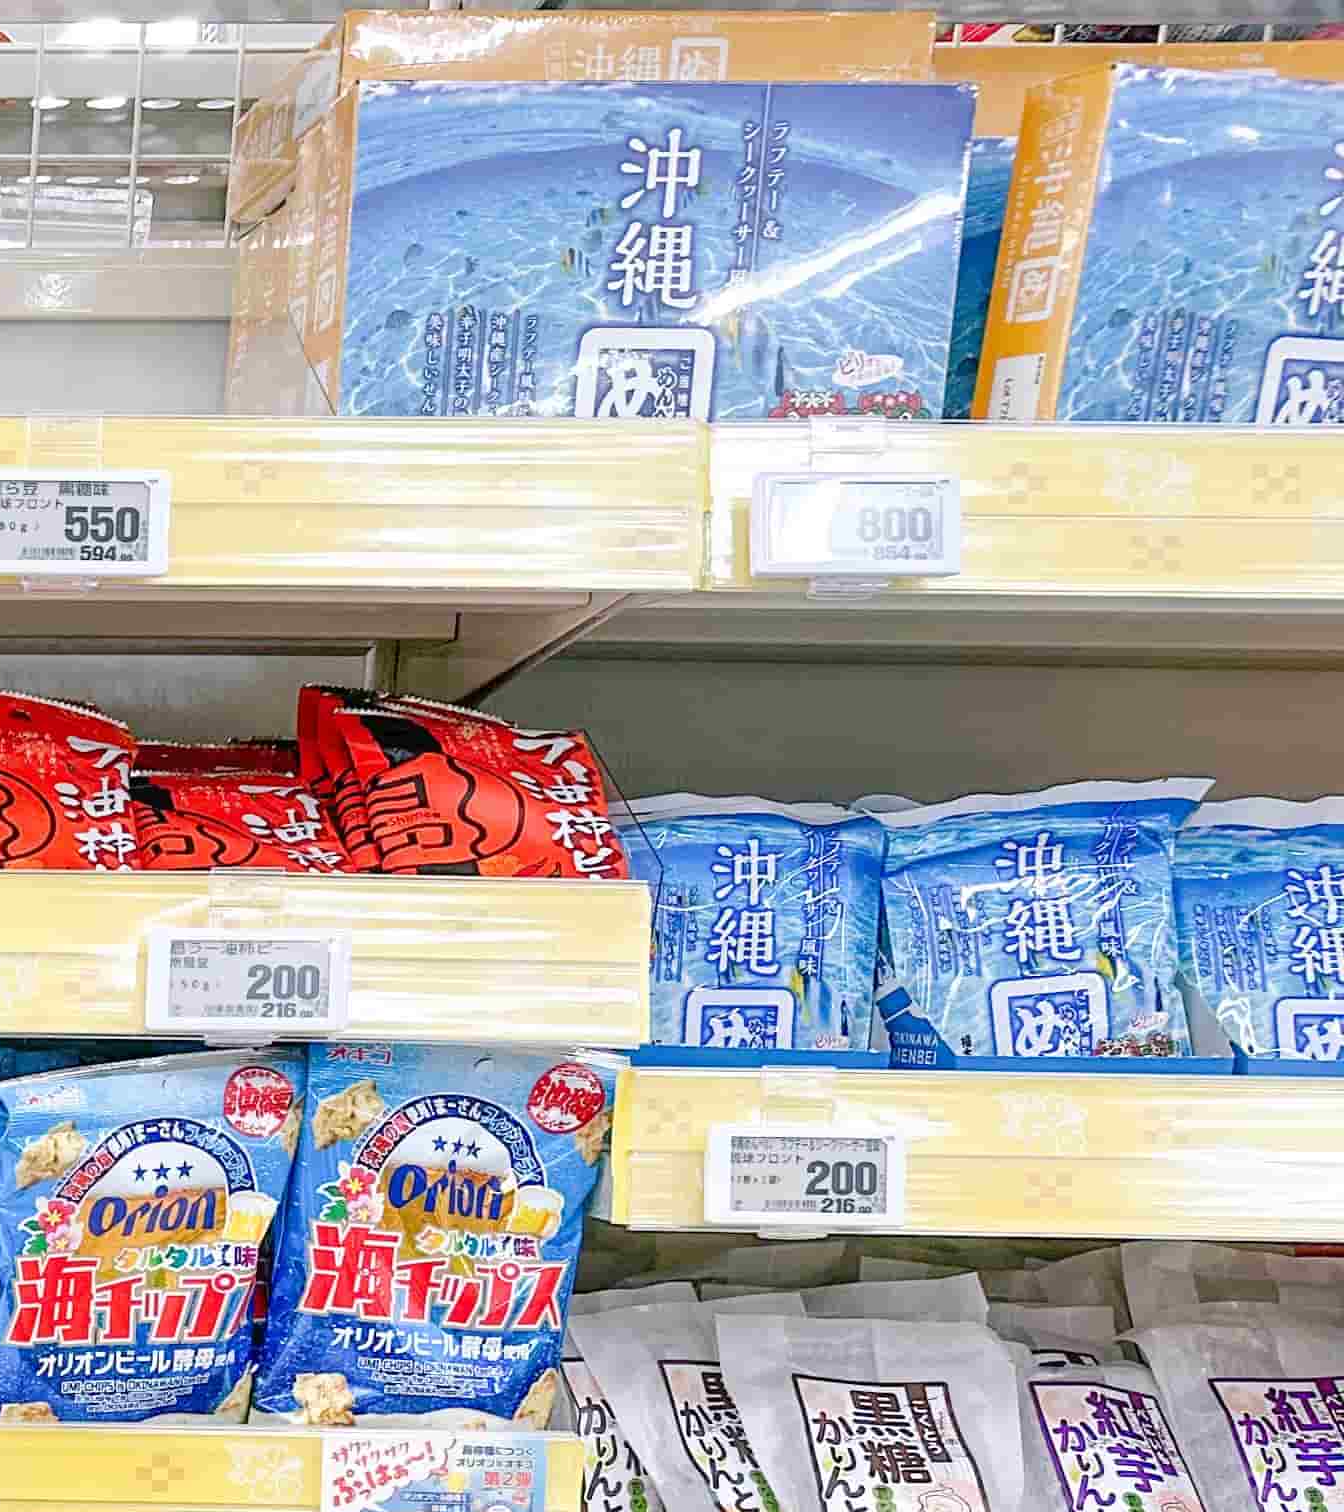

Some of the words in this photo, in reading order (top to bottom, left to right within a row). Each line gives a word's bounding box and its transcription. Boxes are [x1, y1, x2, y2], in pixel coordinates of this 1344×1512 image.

[607, 126, 703, 311] 沖縄
[64, 505, 140, 544] 550
[856, 506, 933, 543] 800
[707, 838, 781, 976] 沖縄
[1002, 830, 1086, 967] 沖縄
[245, 963, 321, 1001] 200
[891, 1031, 940, 1048] OKINAWA
[893, 1048, 938, 1066] MENBEI
[804, 1160, 878, 1197] 200
[301, 1224, 564, 1330] 海チップス
[849, 1389, 933, 1484] 黒糖
[1084, 1390, 1165, 1494] 紅芋
